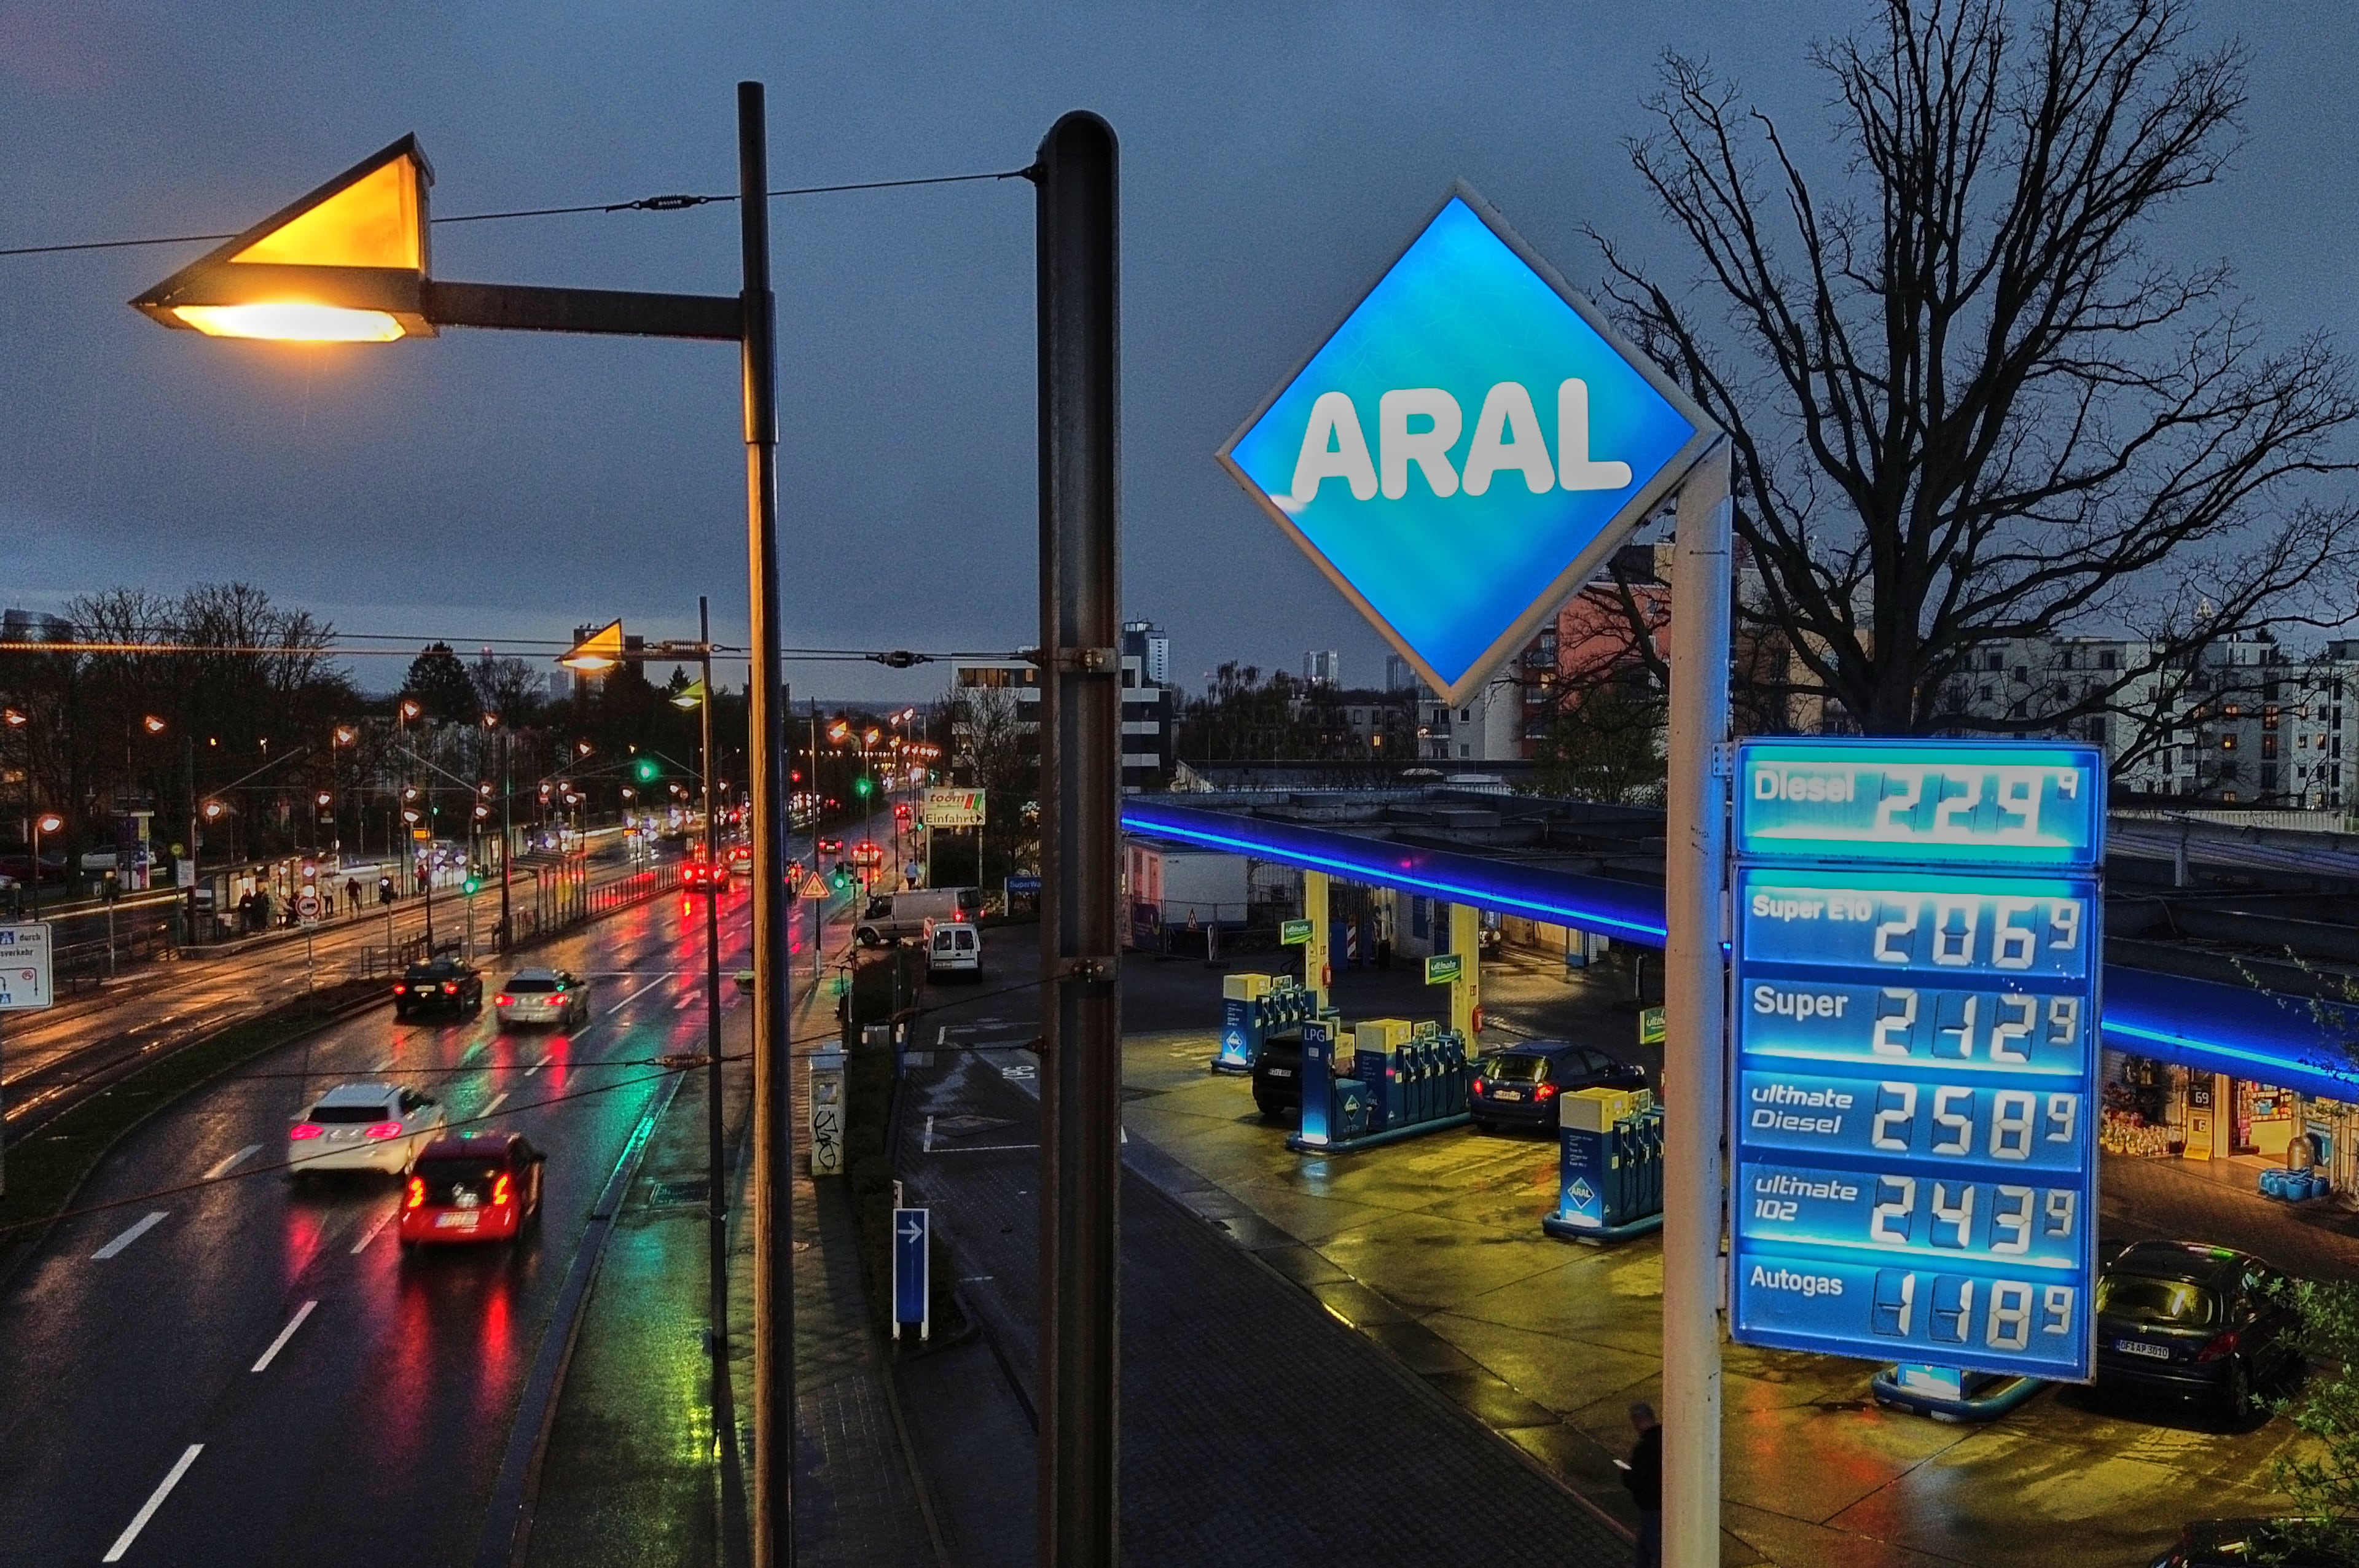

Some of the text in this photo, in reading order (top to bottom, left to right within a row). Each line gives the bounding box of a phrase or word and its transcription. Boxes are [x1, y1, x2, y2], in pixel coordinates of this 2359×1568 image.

[1291, 378, 1632, 502] ARAL
[930, 794, 964, 802] toom
[1755, 770, 1855, 802] Diesel
[926, 814, 975, 823] Einfahrt
[1753, 895, 1824, 922] Super
[1828, 898, 1872, 921] E10
[1754, 986, 1848, 1021] Super
[1304, 1029, 1325, 1042] LPG
[1751, 1083, 1853, 1110] ultimate
[2196, 1091, 2209, 1104] 69
[1751, 1108, 1842, 1134] Diesel
[1571, 1187, 1590, 1198] ARAL
[1756, 1175, 1858, 1201] ultimate
[1755, 1198, 1798, 1222] 102
[1750, 1265, 1843, 1297] Autogas
